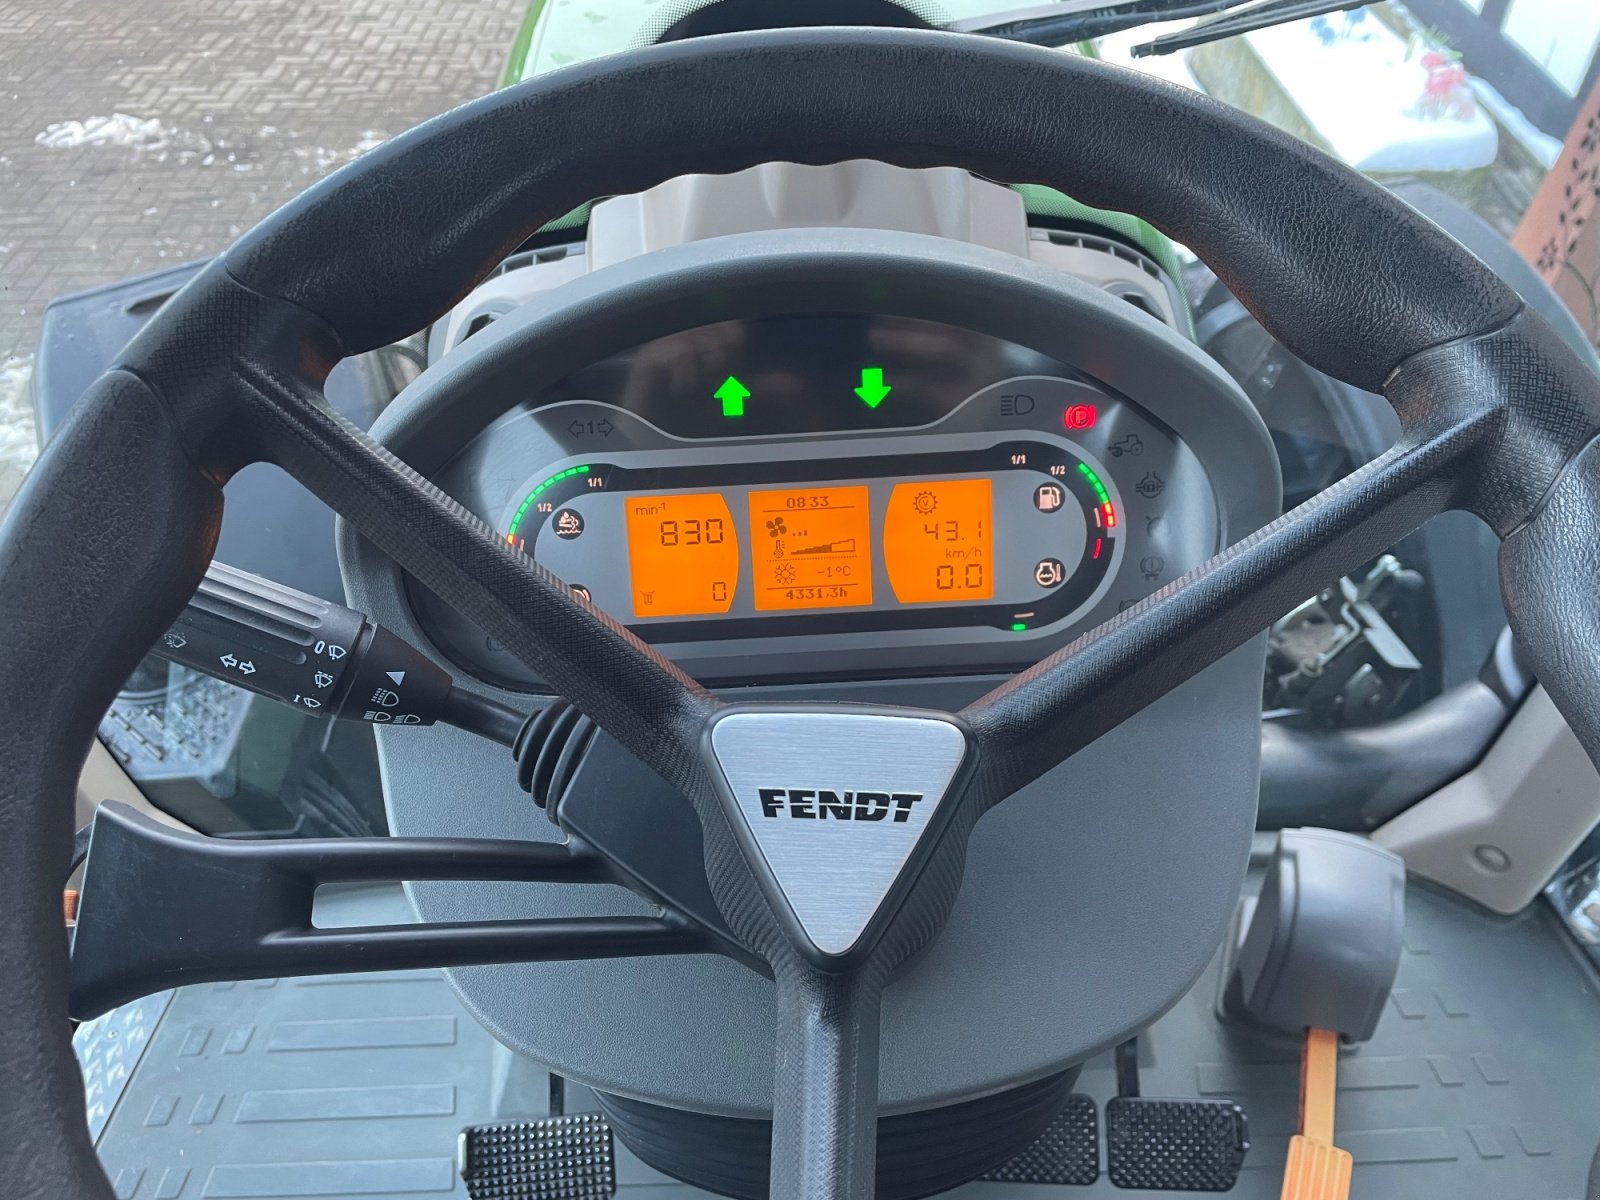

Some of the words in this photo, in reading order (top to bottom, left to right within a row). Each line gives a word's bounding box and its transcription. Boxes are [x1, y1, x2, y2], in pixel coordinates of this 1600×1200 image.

[1075, 410, 1087, 424] P
[587, 421, 594, 434] 1
[1011, 454, 1026, 465] 1/1
[1050, 465, 1066, 475] 1/2
[587, 477, 603, 487] 1/1
[537, 503, 553, 512] 1/2
[660, 518, 724, 546] 830
[924, 520, 982, 541] 43.1
[945, 546, 983, 559] km/h
[936, 563, 983, 590] 0.0
[712, 581, 727, 602] 0
[758, 788, 924, 823] FENDT
